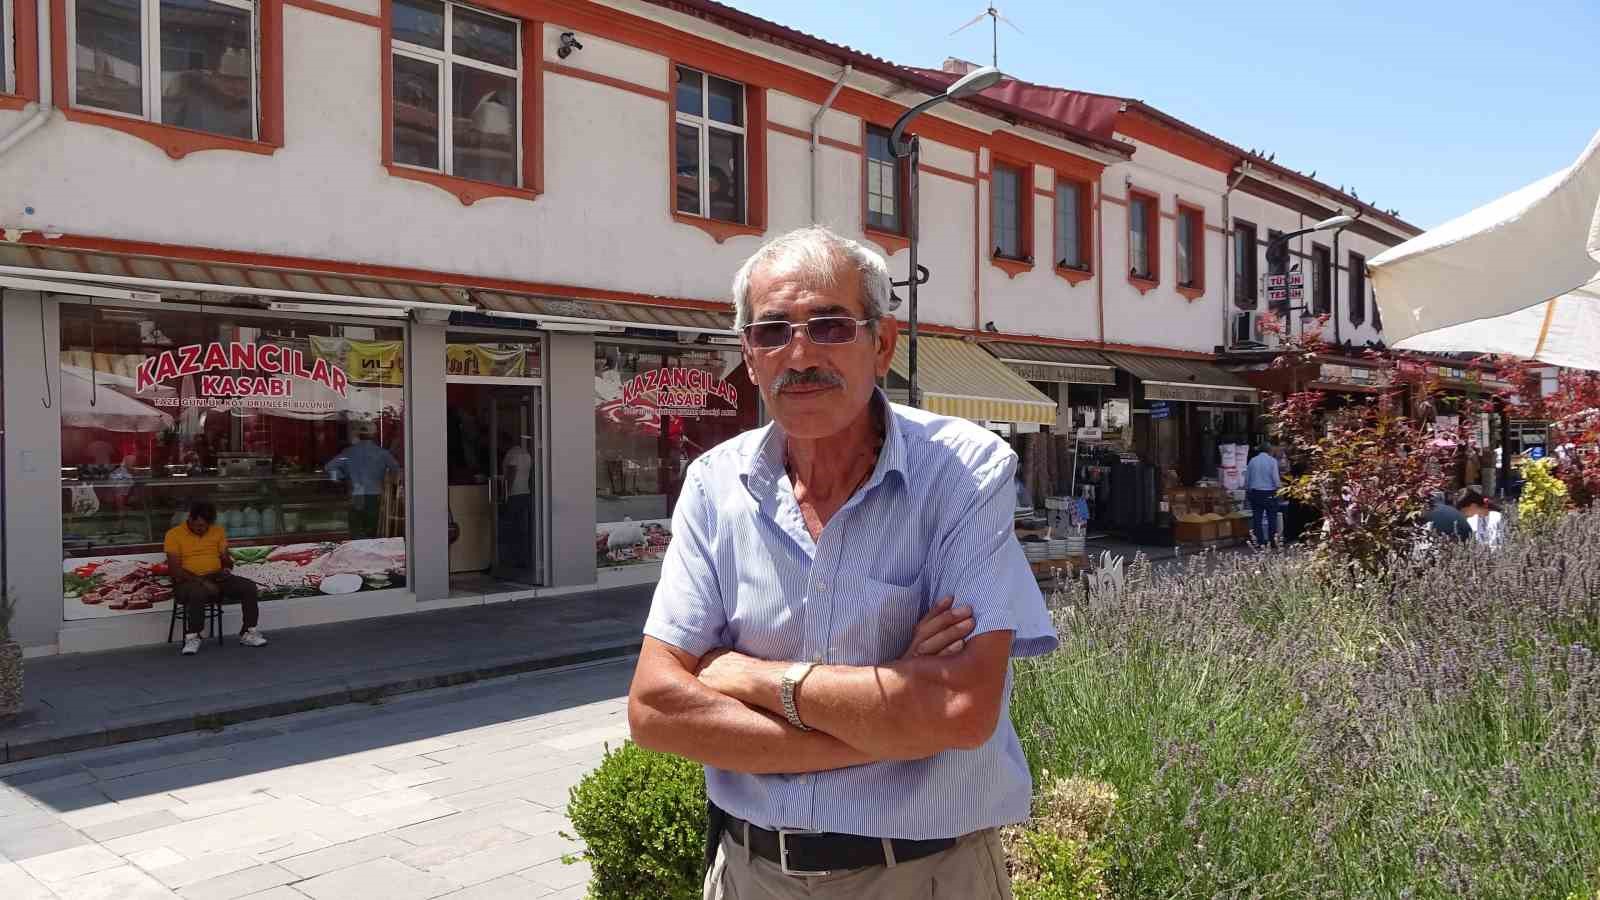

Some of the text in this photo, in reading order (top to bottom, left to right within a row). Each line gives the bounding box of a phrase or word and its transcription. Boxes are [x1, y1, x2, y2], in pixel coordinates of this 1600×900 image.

[135, 342, 348, 399] KAZANCILAR
[202, 376, 292, 398] KASABI
[623, 367, 738, 409] KAZANCILAR
[154, 398, 179, 407] TAZE
[656, 391, 707, 407] KASABI
